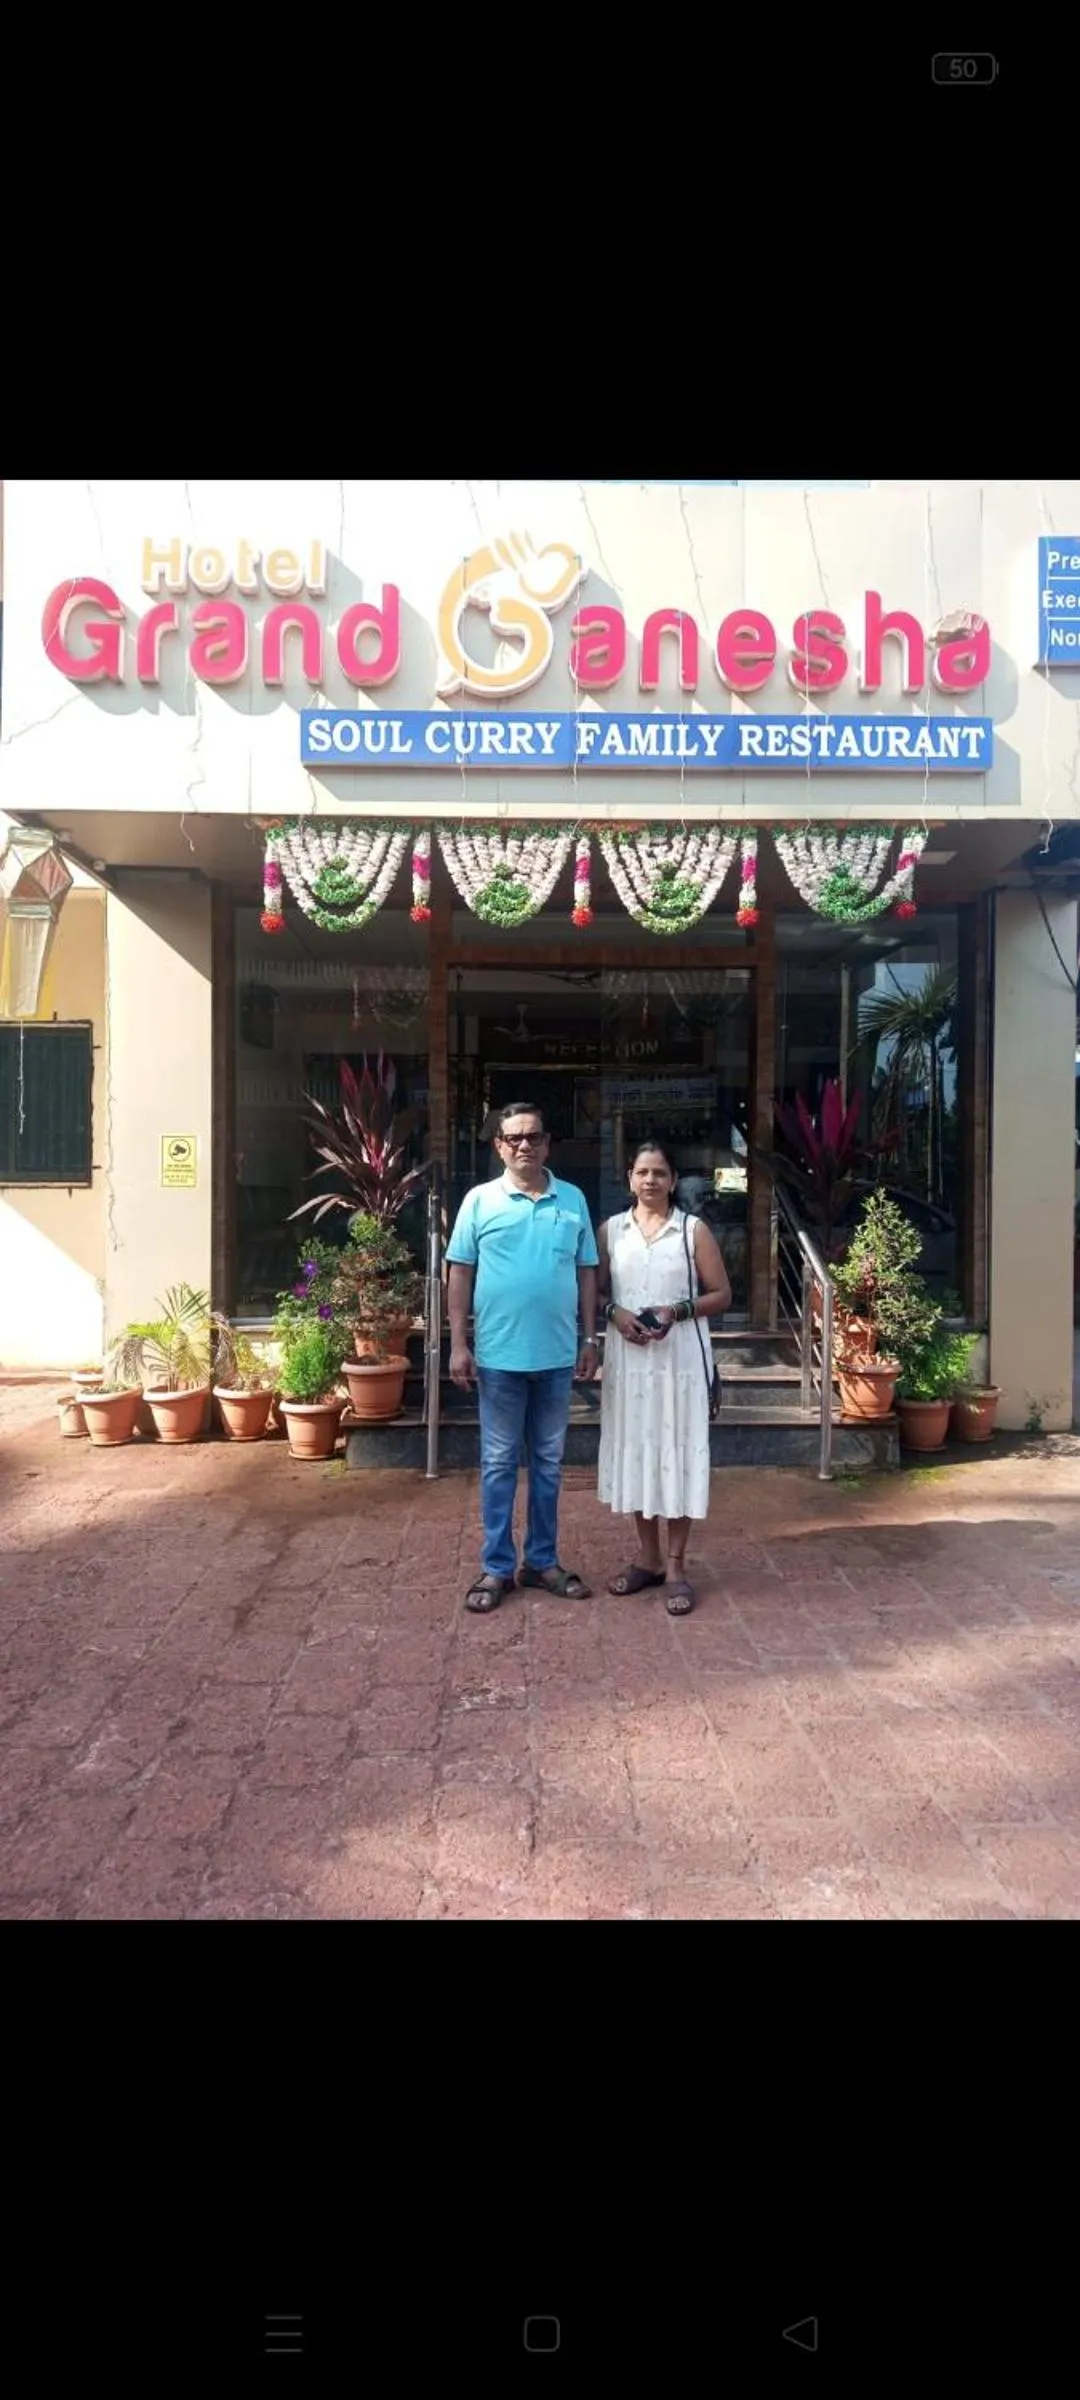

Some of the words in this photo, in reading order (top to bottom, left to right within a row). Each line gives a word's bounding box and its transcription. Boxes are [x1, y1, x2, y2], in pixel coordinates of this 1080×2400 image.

[143, 538, 326, 594] Hotel
[42, 577, 401, 685] Grand
[436, 530, 992, 697] Ganesha
[1042, 590, 1080, 609] Exe
[309, 719, 412, 754] SOUL
[425, 720, 562, 756] CURRY
[577, 722, 725, 758] FAMILY
[739, 724, 985, 759] RESTAURANT
